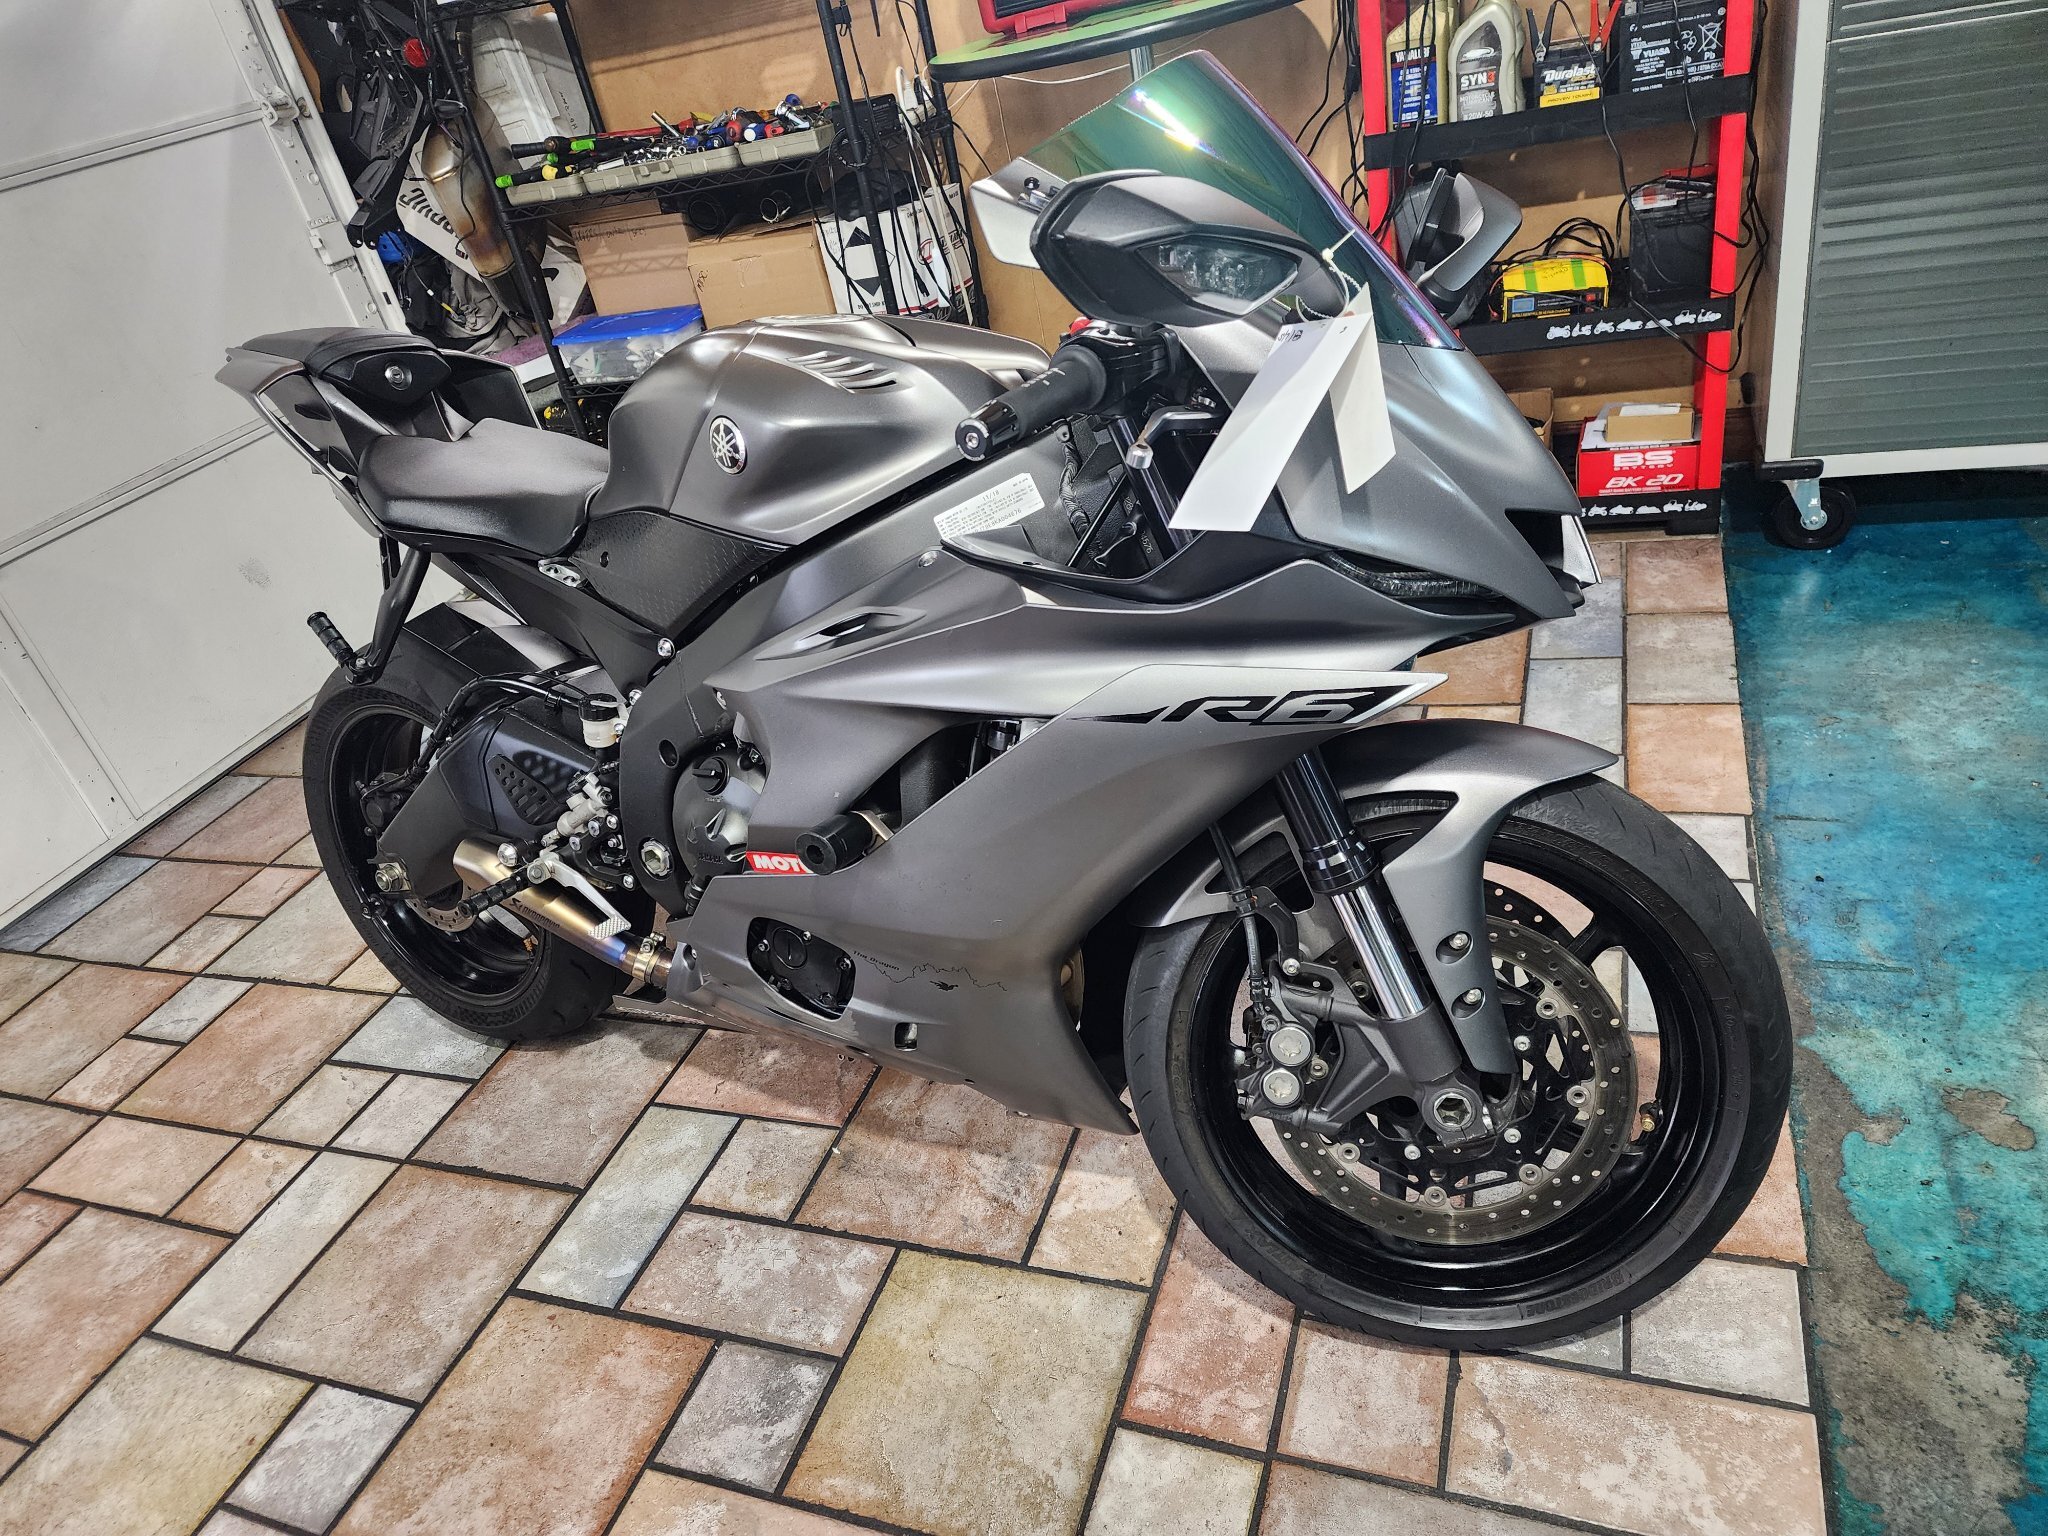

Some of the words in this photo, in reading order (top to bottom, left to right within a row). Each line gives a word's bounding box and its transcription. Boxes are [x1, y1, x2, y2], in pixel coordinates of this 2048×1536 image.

[1643, 46, 1671, 58] YUASA
[1704, 51, 1716, 61] Pb
[1460, 70, 1496, 88] SYN3
[1543, 63, 1597, 83] Duralast
[1613, 463, 1674, 472] BATTERY
[1614, 450, 1674, 468] BS
[1605, 476, 1645, 489] BK
[1645, 473, 1684, 486] 20
[1161, 690, 1395, 727] R6
[752, 854, 814, 874] MOT
